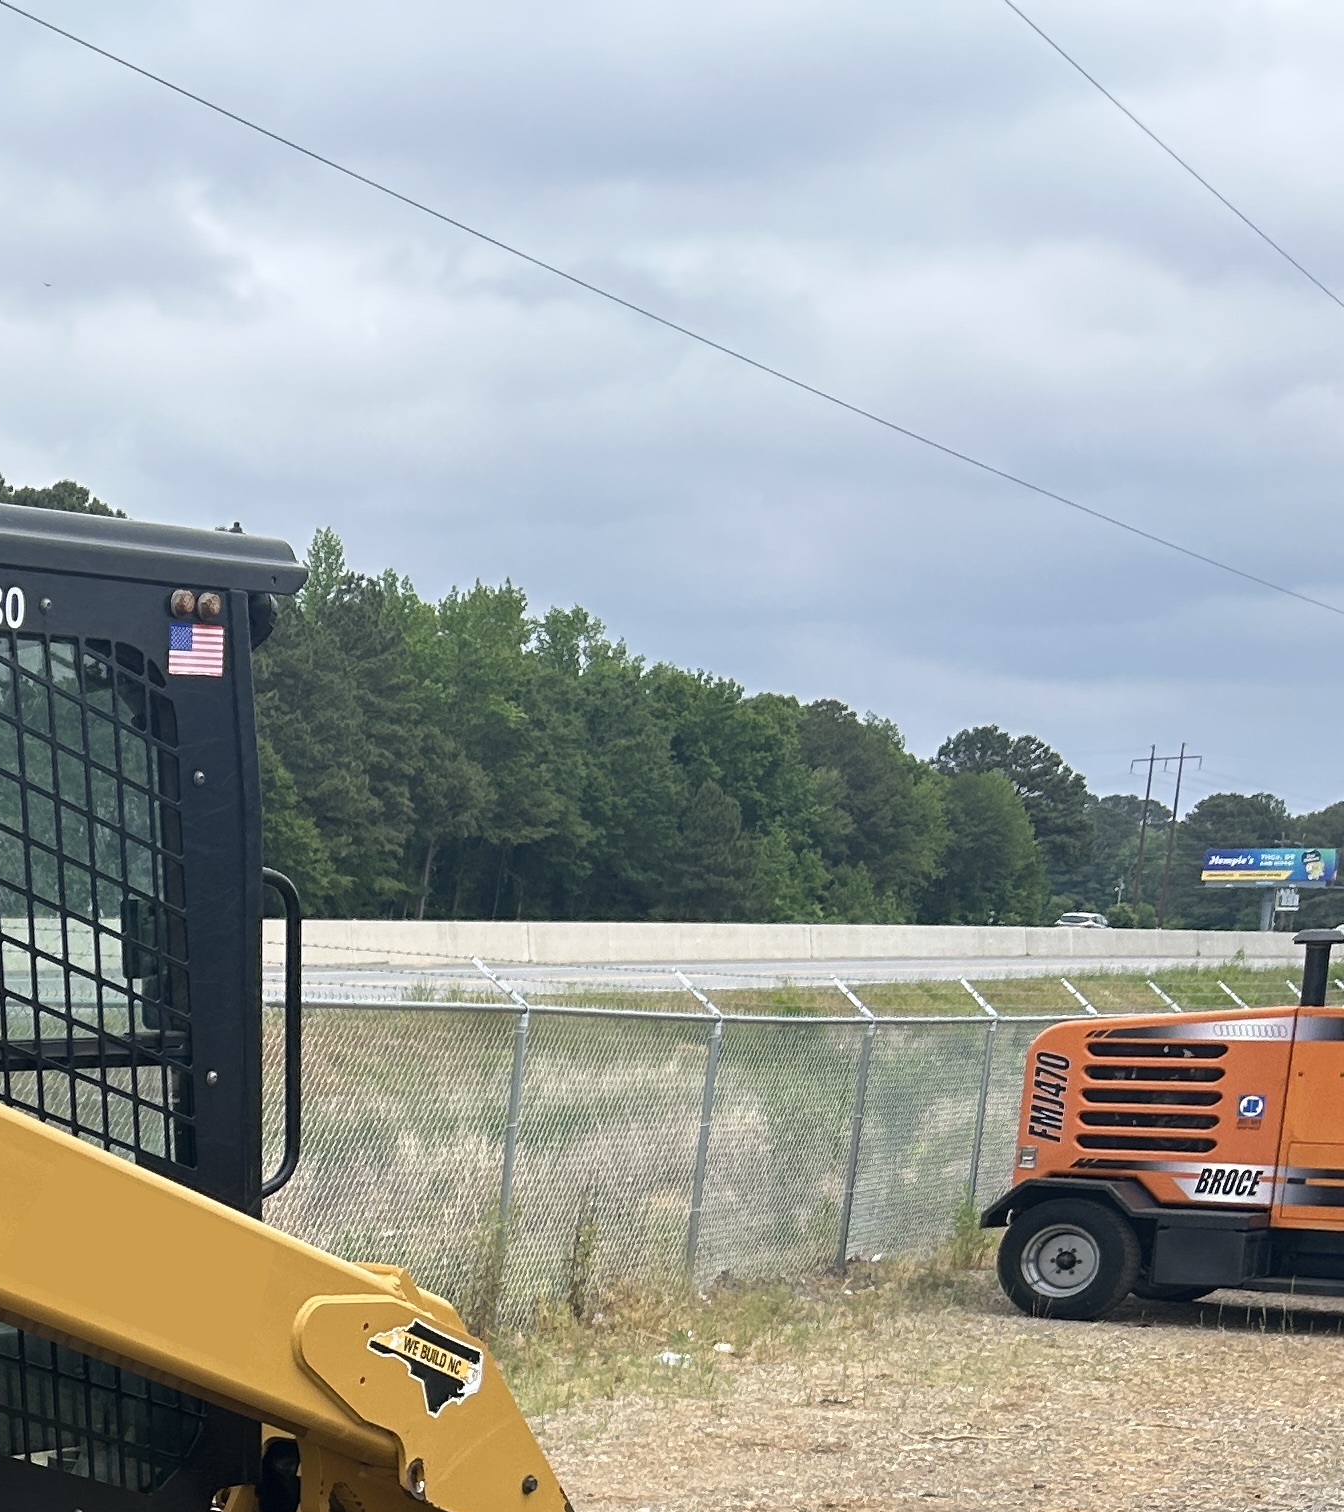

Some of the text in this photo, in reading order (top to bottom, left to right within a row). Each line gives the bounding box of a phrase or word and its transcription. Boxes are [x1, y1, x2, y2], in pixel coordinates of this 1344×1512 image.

[1029, 1052, 1069, 1142] FMJ470
[1194, 1168, 1264, 1196] BROCE
[403, 1335, 462, 1376] WE BUILD NC
